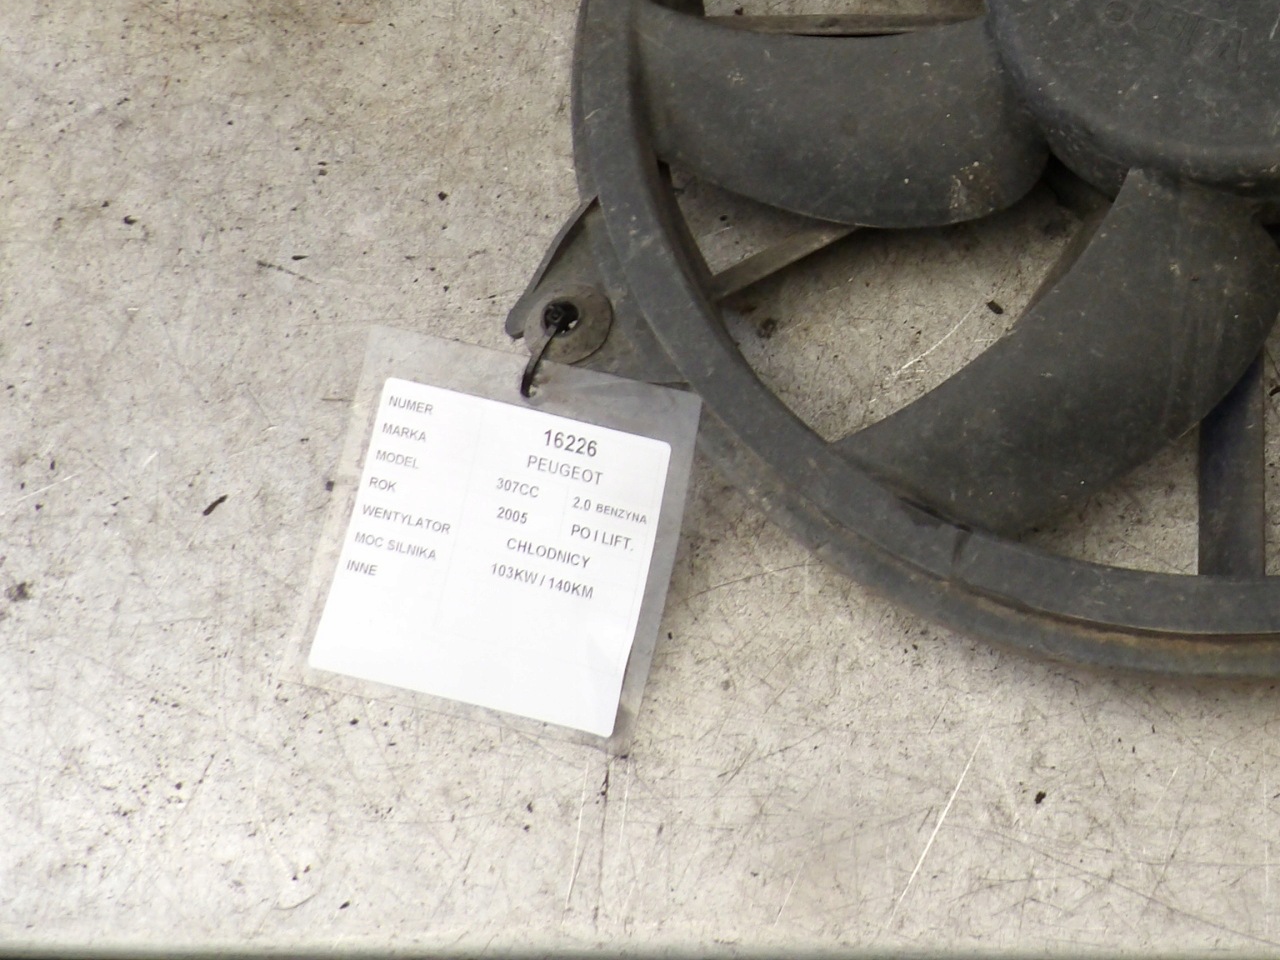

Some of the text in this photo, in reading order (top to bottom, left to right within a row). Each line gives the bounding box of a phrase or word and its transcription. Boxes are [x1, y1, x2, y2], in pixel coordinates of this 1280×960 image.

[388, 395, 434, 415] NUMER
[382, 422, 427, 442] MARKA
[543, 428, 598, 457] 16226
[375, 449, 419, 469] MODEL
[526, 454, 603, 485] PEUGEOT
[369, 476, 397, 492] ROK
[496, 477, 540, 498] 307CC
[362, 504, 451, 534] WENTYLATOR
[496, 506, 528, 524] 2005
[572, 496, 647, 525] 2.0 BENZYNA
[354, 531, 437, 560] MOC SILNIKA
[570, 524, 591, 539] PO
[601, 531, 634, 551] LIFT.
[346, 559, 378, 576] INNE
[491, 563, 594, 599] 103KW / 140KM
